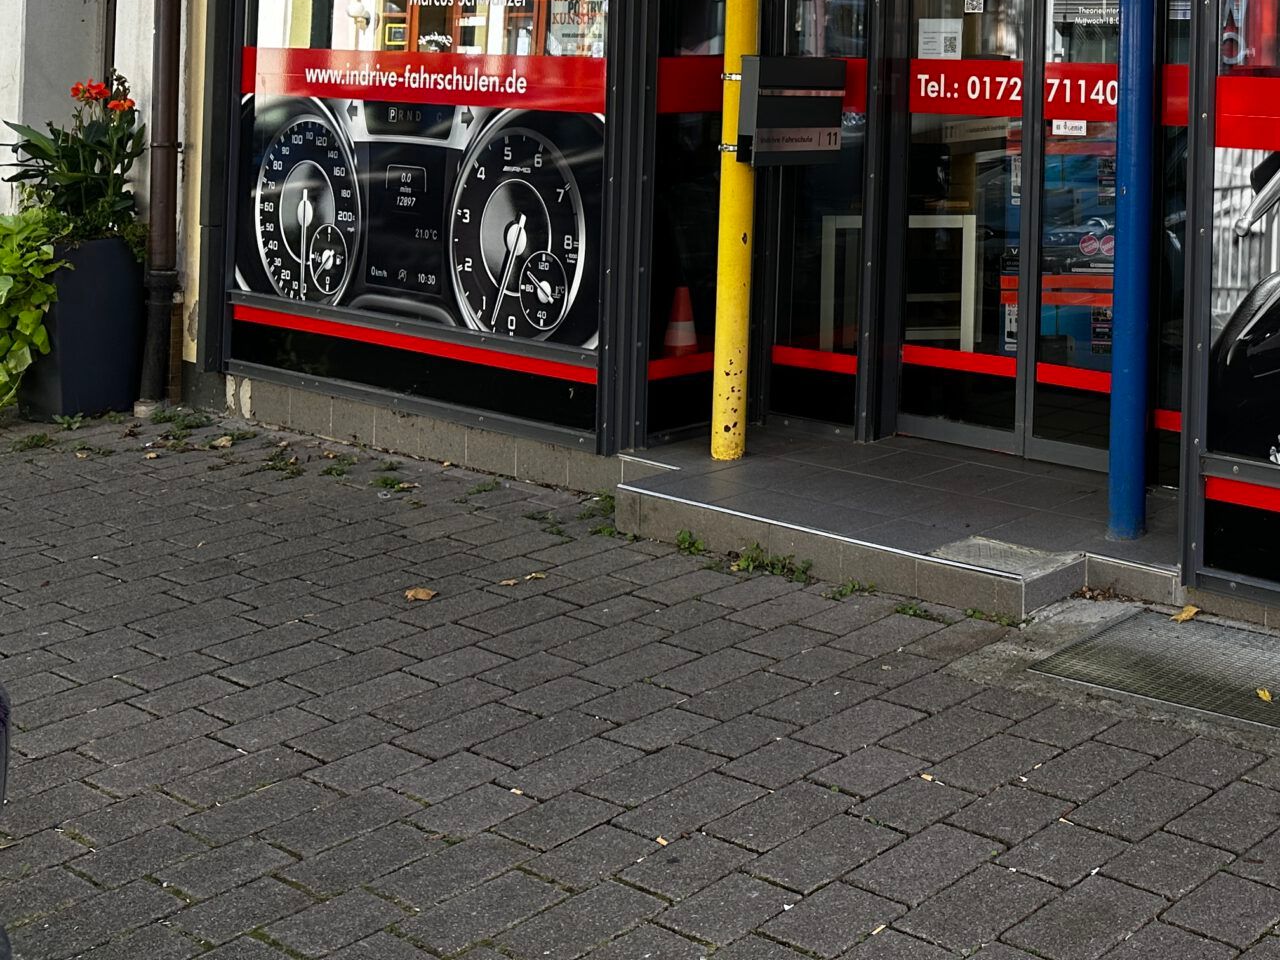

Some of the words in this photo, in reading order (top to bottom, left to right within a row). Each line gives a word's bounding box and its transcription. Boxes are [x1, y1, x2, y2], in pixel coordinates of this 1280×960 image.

[305, 64, 528, 95] www.indrive-fahrschulen.de
[917, 74, 959, 99] Tel.:
[967, 75, 1022, 100] 0172
[291, 134, 303, 145] 100
[306, 132, 314, 140] 110
[315, 136, 327, 146] 120
[826, 131, 838, 146] 11
[281, 146, 290, 155] 90
[327, 150, 339, 159] 140
[504, 147, 512, 161] 5
[272, 161, 283, 171] 80
[534, 154, 543, 167] 6
[333, 166, 346, 177] 160
[477, 167, 486, 181] 4
[401, 172, 412, 183] 0.0
[340, 190, 351, 198] 180
[556, 189, 565, 203] 7
[264, 202, 274, 212] 60
[396, 196, 417, 207] 12897
[337, 211, 352, 222] 200
[462, 209, 470, 223] 3
[265, 223, 274, 232] 50
[268, 240, 279, 250] 40
[564, 235, 573, 250] 8
[274, 258, 282, 267] 30
[464, 257, 473, 272] 2
[537, 262, 550, 271] 120
[280, 270, 291, 280] 20
[417, 273, 436, 285] 10:30
[482, 296, 487, 310] 1
[536, 310, 547, 319] 40
[507, 316, 516, 330] 0
